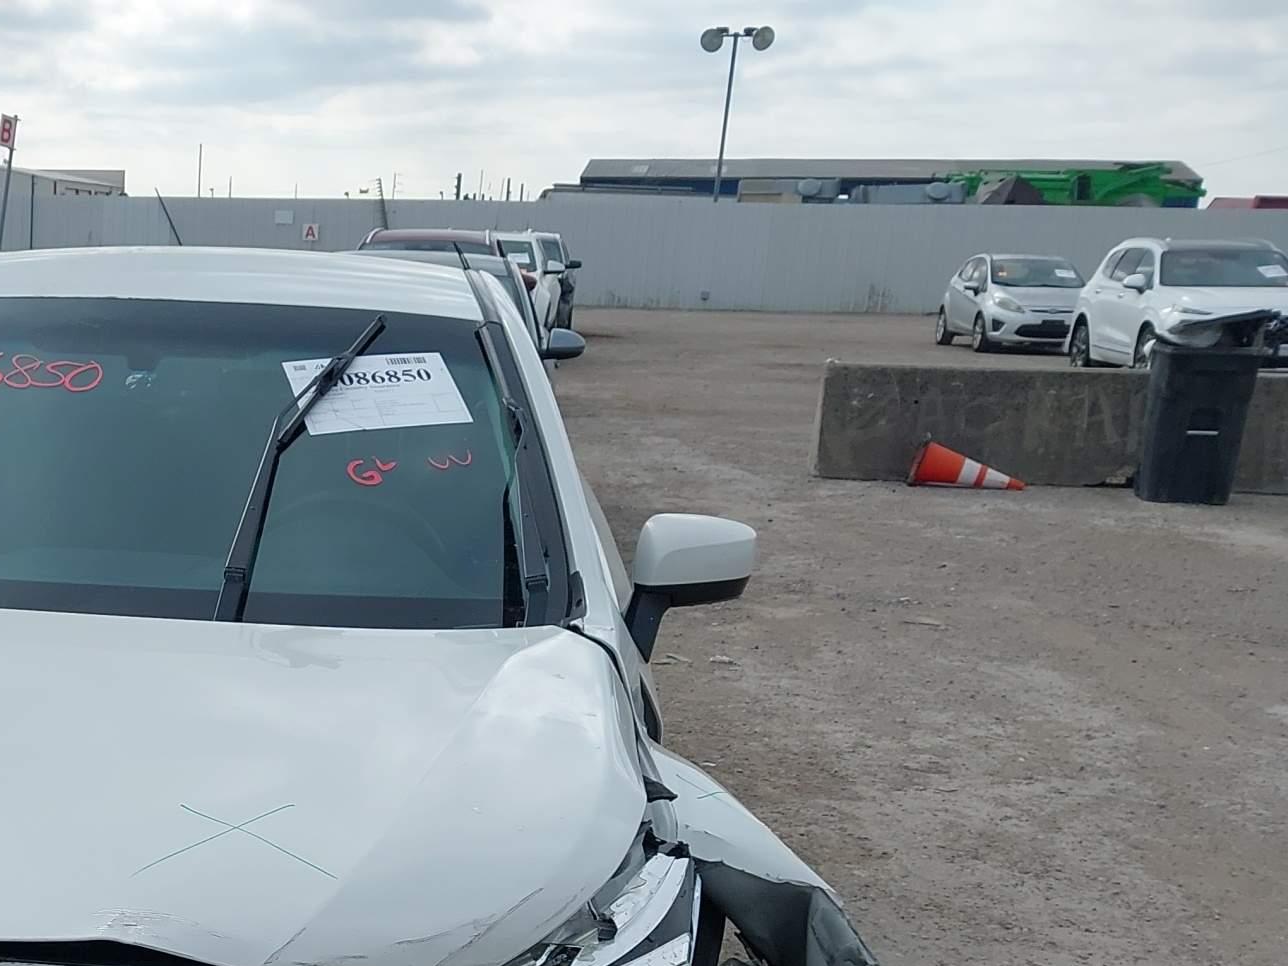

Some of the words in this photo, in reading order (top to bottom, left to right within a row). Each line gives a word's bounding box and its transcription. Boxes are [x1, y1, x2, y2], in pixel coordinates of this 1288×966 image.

[0, 118, 12, 144] B
[305, 225, 316, 239] A
[331, 368, 432, 387] 086850
